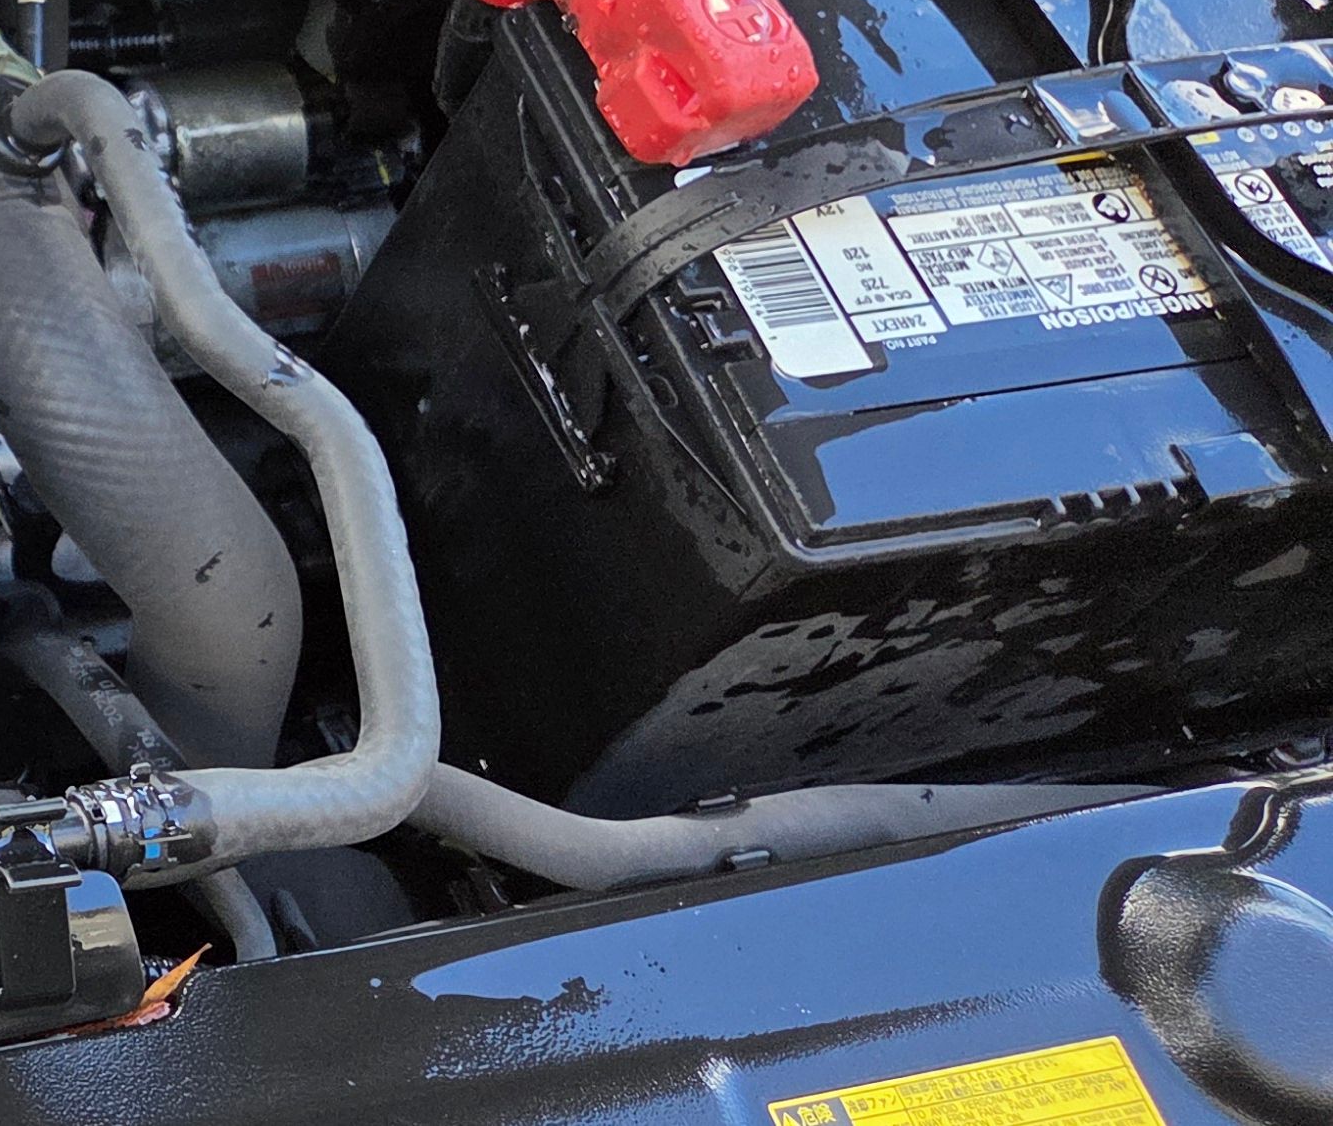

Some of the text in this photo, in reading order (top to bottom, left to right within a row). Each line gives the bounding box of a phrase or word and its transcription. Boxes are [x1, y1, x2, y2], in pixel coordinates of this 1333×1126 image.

[815, 202, 845, 218] 12V
[989, 210, 1006, 222] DO
[969, 212, 990, 224] NOT
[950, 226, 977, 239] OPEN
[976, 224, 998, 235] NOT
[996, 221, 1013, 233] DO
[840, 244, 871, 261] 120
[944, 246, 974, 260] HELP
[919, 260, 969, 276] MEDICAL
[858, 275, 890, 292] 725
[926, 273, 951, 288] GET
[997, 276, 1027, 289] WITH
[885, 289, 913, 301] CCA
[961, 288, 1036, 307] IMMEDIATELY
[977, 303, 1008, 318] EYES
[869, 313, 927, 333] 24REXT
[904, 334, 937, 347] PART
